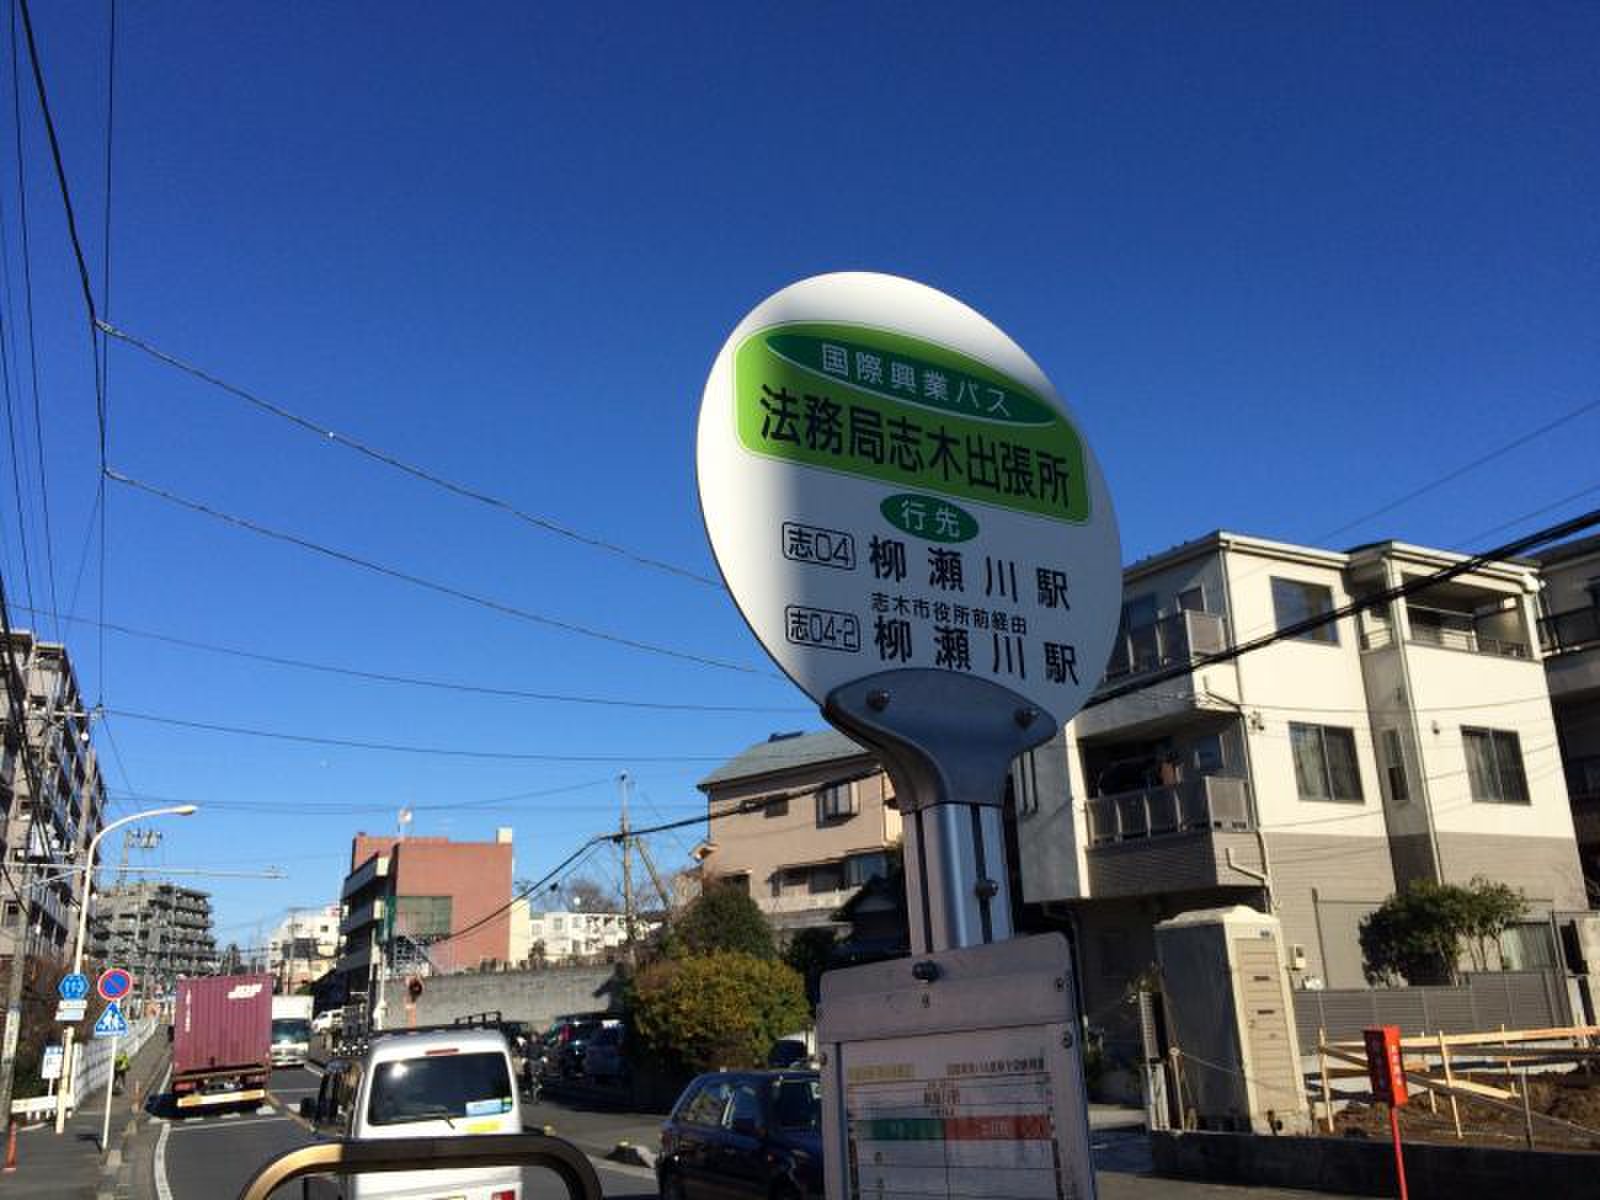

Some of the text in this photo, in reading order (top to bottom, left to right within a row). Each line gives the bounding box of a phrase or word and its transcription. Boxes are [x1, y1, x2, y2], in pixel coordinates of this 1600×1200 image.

[821, 343, 1010, 417] 国際興業バス
[760, 383, 1070, 508] 法務局志木出張所
[901, 498, 961, 537] 行先
[788, 528, 850, 567] 志04
[869, 534, 1071, 610] 柳瀬川駅
[790, 609, 857, 648] 志04-2
[871, 592, 1027, 636] 志木市役所前経由
[874, 615, 1079, 686] 柳瀬川駅
